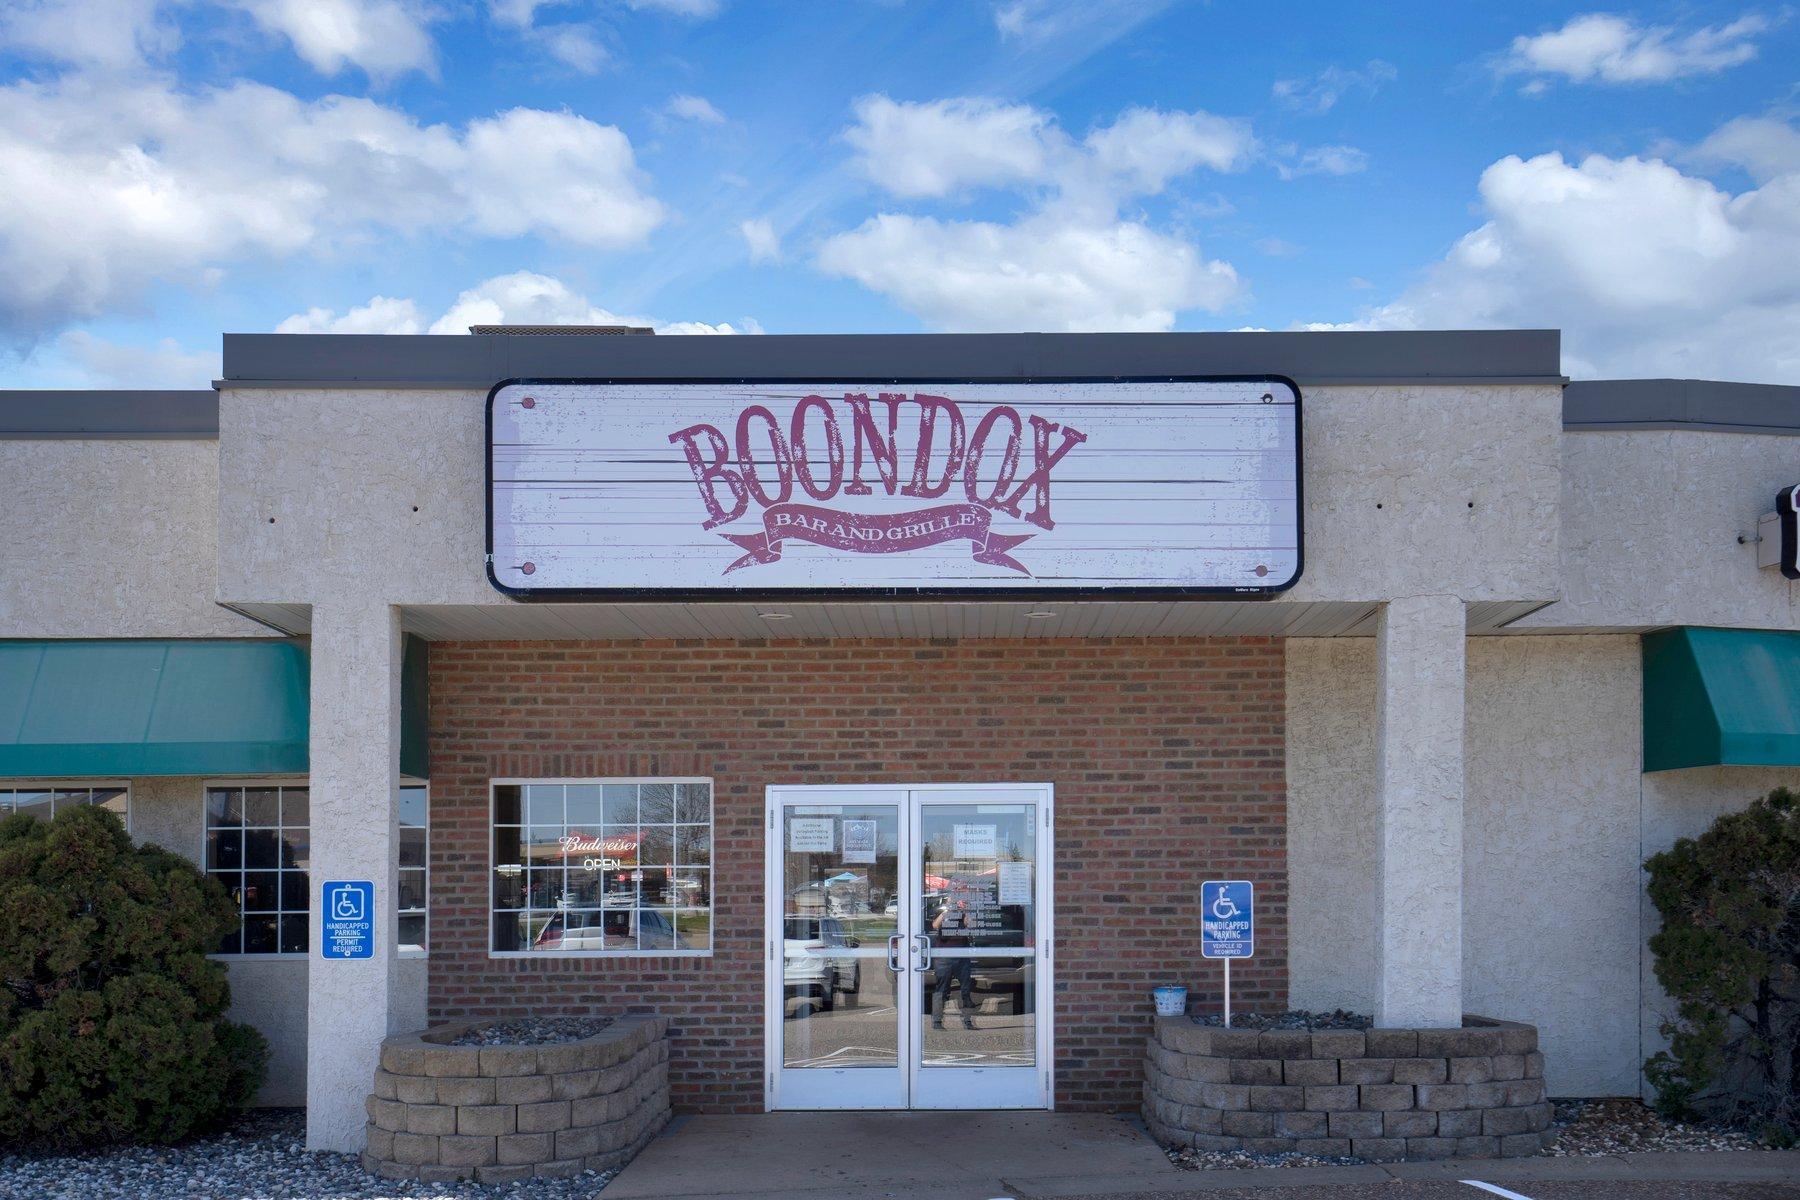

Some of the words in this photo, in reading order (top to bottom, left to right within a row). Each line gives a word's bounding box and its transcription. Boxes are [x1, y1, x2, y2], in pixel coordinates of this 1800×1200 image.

[668, 393, 1088, 531] BOONDOX
[774, 512, 826, 531] BAR
[822, 525, 884, 541] AND
[887, 512, 978, 540] GRILLE
[559, 836, 638, 852] Budweiser
[584, 858, 620, 870] OPEN
[1205, 921, 1249, 930] HANDICAPPED
[1213, 931, 1241, 939] PARKING
